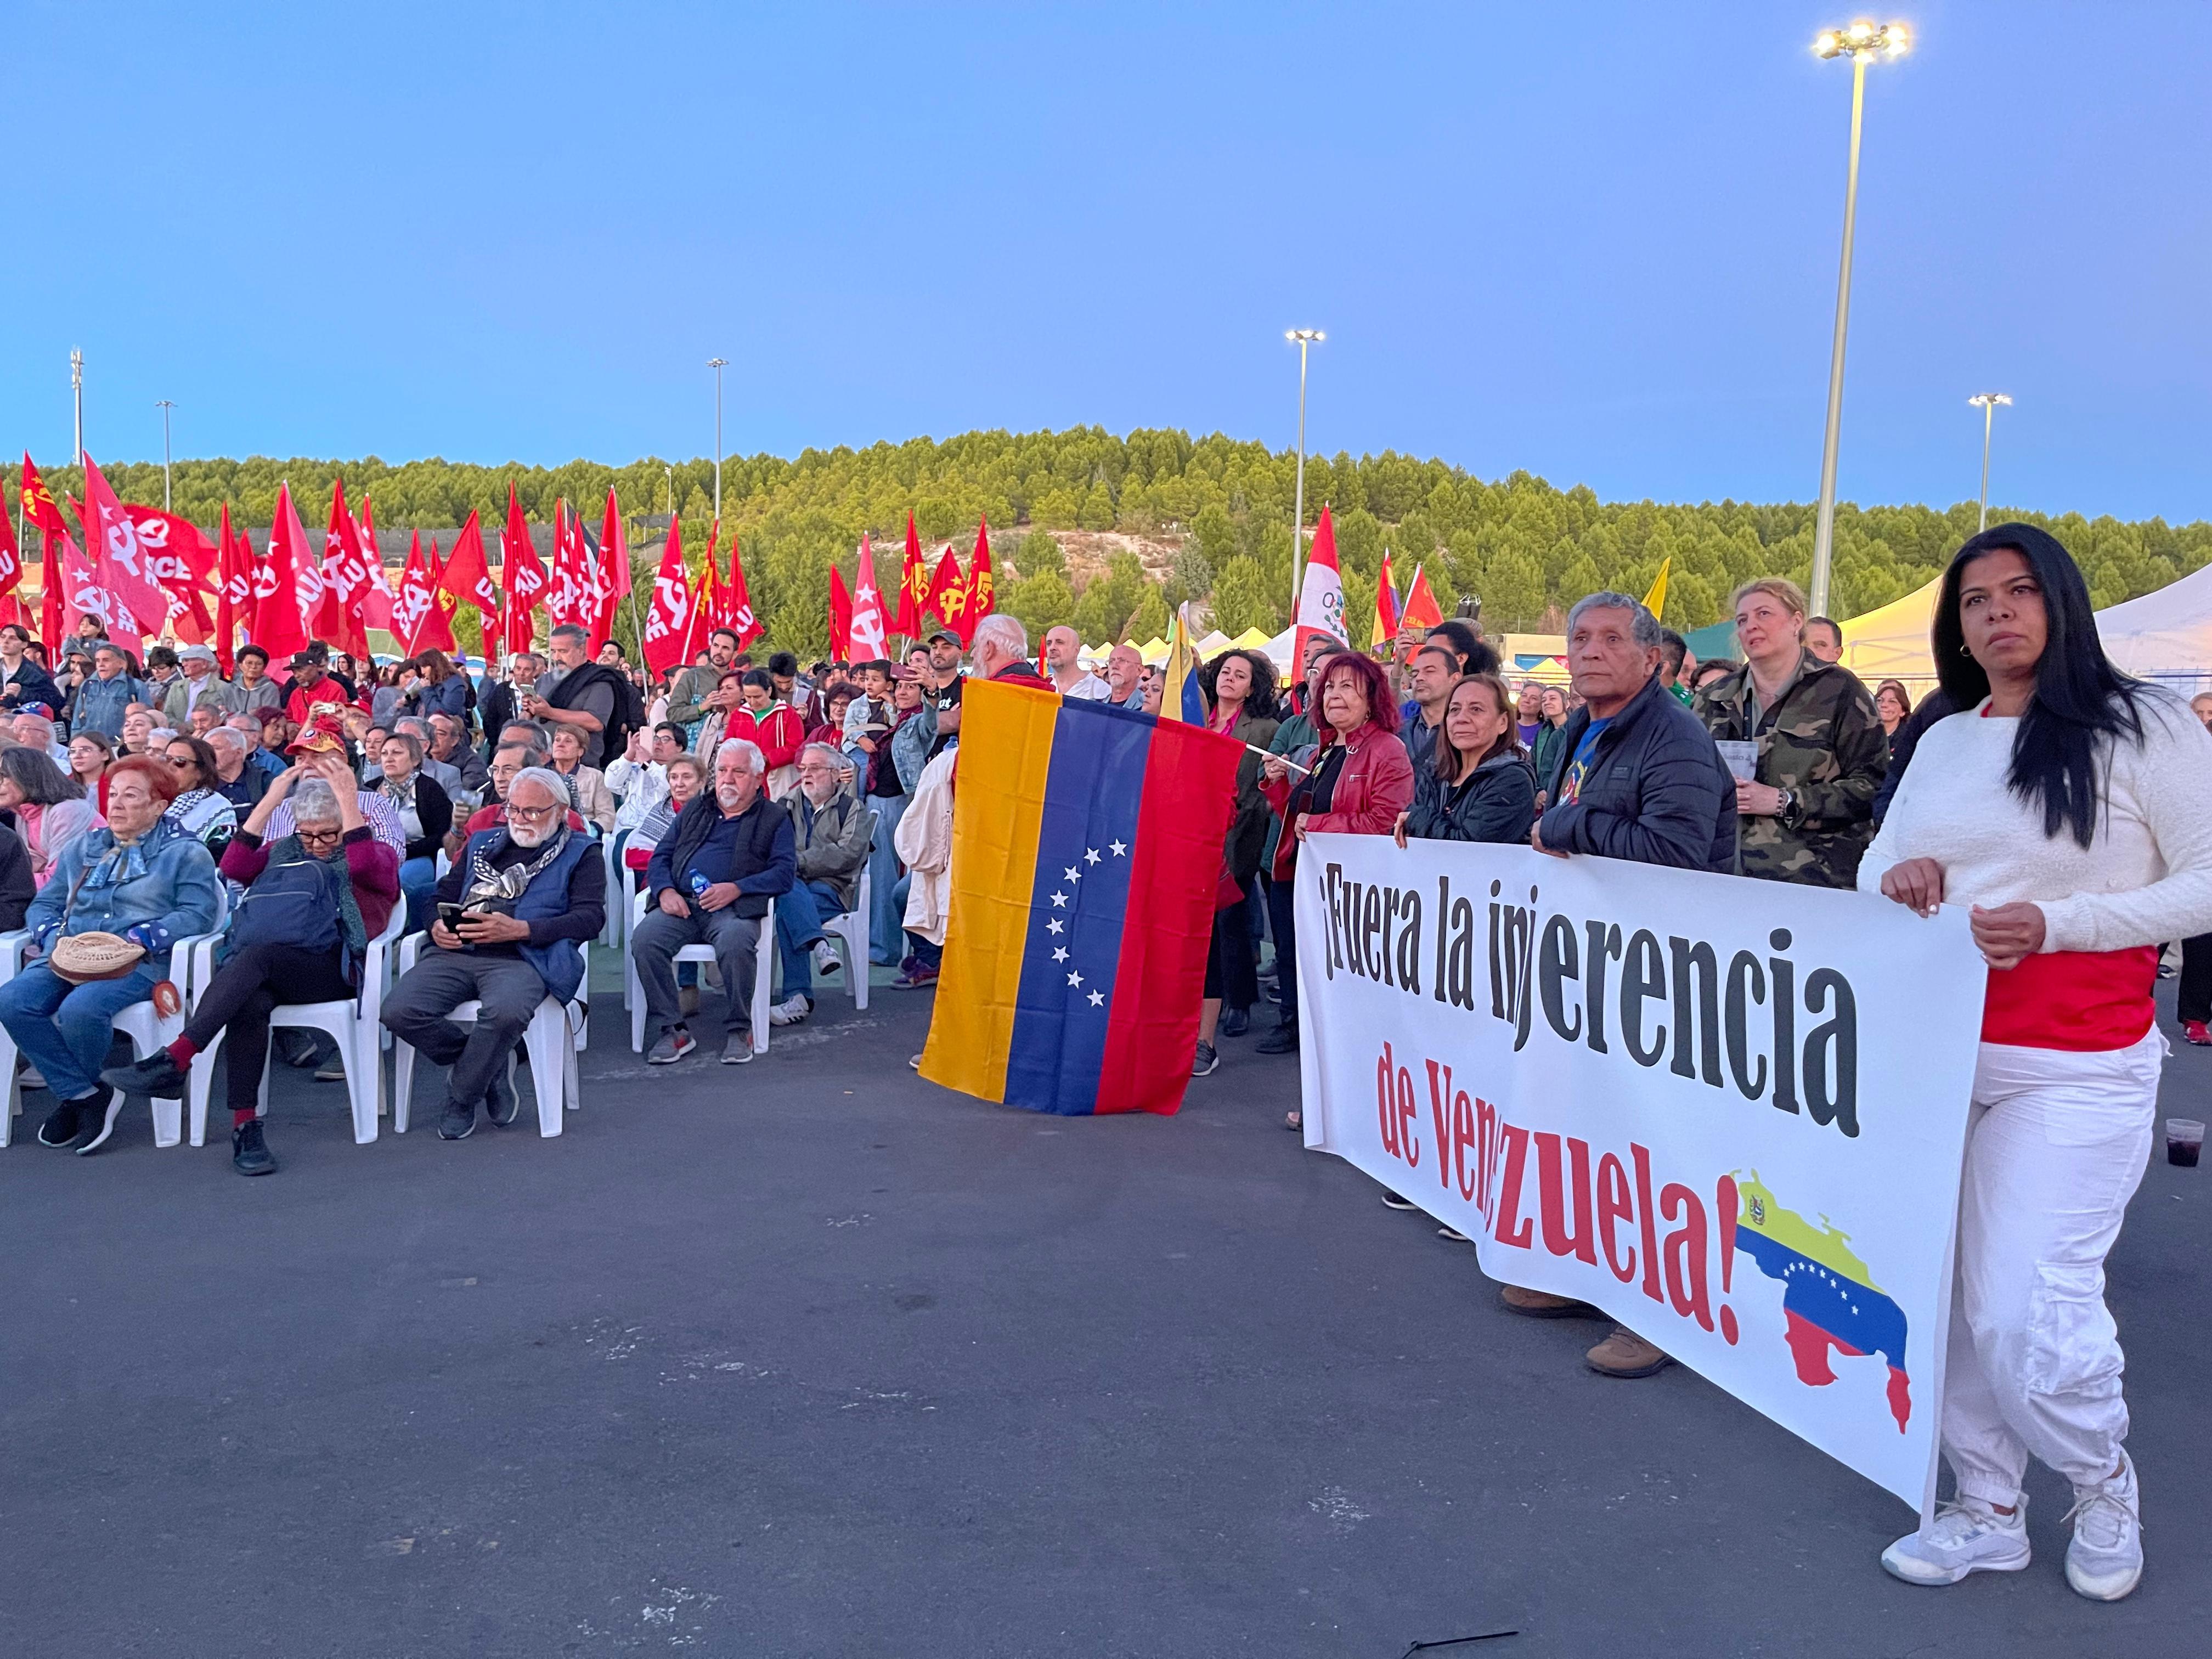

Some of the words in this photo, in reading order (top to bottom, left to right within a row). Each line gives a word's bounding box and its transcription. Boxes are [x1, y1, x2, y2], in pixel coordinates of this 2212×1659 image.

[114, 592, 138, 636] CE
[645, 601, 670, 643] CE
[1319, 862, 1422, 996] ¡Fuera
[1434, 875, 1474, 1011] la
[1489, 879, 1860, 1138] injerencia
[1377, 1040, 1419, 1169] de
